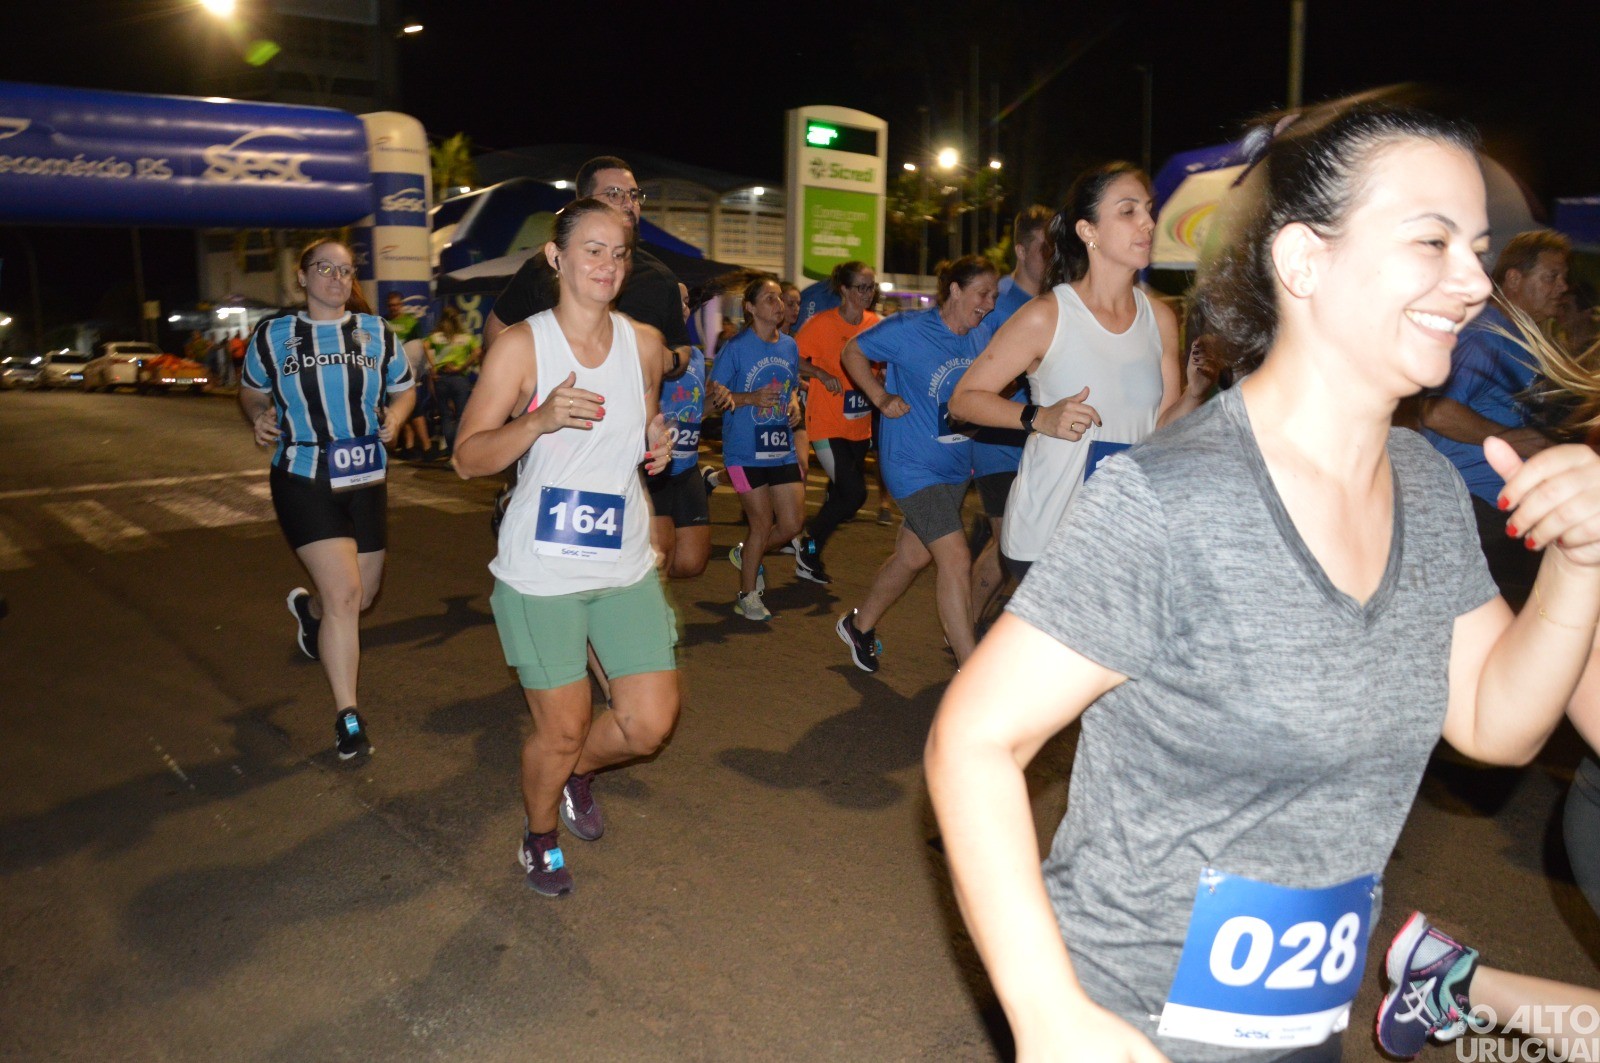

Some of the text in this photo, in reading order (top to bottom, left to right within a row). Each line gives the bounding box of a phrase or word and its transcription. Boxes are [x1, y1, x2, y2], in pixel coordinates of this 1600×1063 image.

[928, 366, 948, 397] FAMÍLIA
[945, 357, 960, 367] QUE
[333, 443, 376, 469] 097
[760, 431, 788, 446] 162
[549, 501, 617, 536] 164
[1209, 912, 1361, 990] 028
